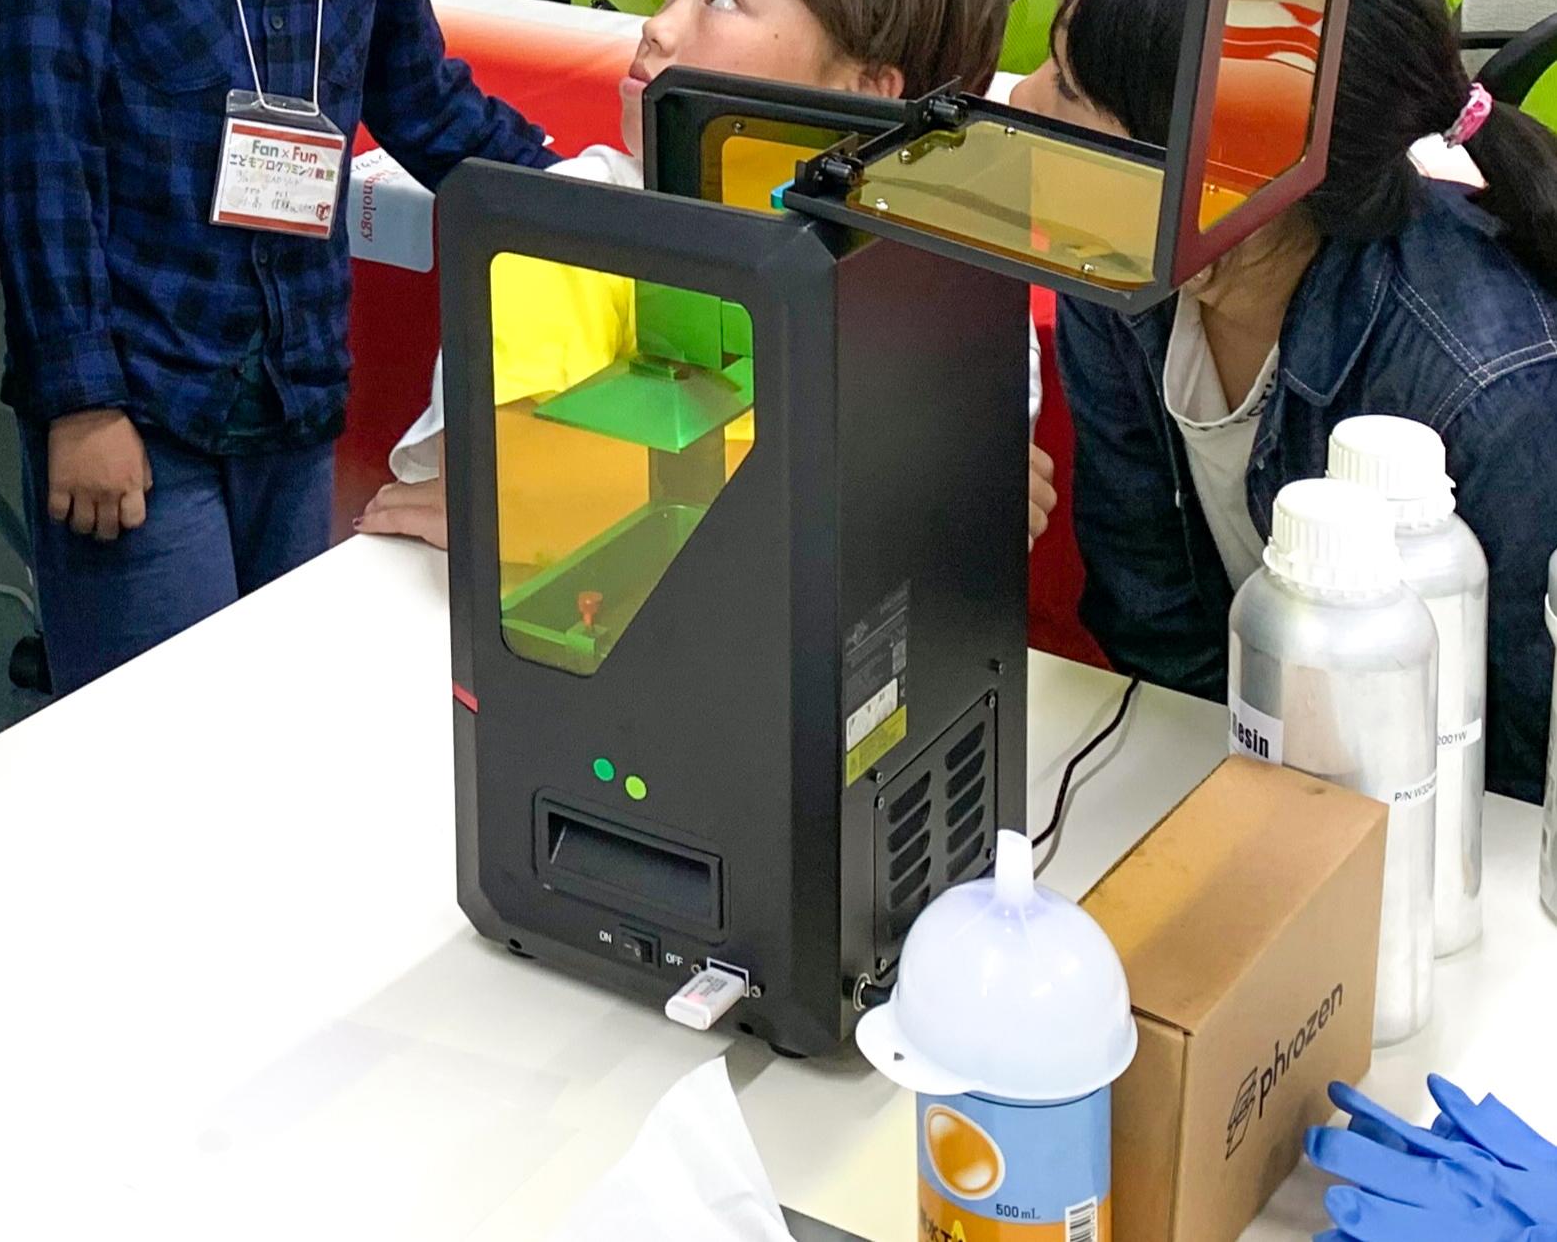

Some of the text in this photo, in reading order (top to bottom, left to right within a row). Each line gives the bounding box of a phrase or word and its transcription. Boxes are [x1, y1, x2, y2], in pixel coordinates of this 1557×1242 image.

[251, 140, 279, 158] Fan
[292, 146, 318, 164] Fun
[599, 930, 612, 943] ON
[665, 953, 683, 966] OFF
[1258, 983, 1343, 1119] phrozen
[996, 1204, 1019, 1218] 500
